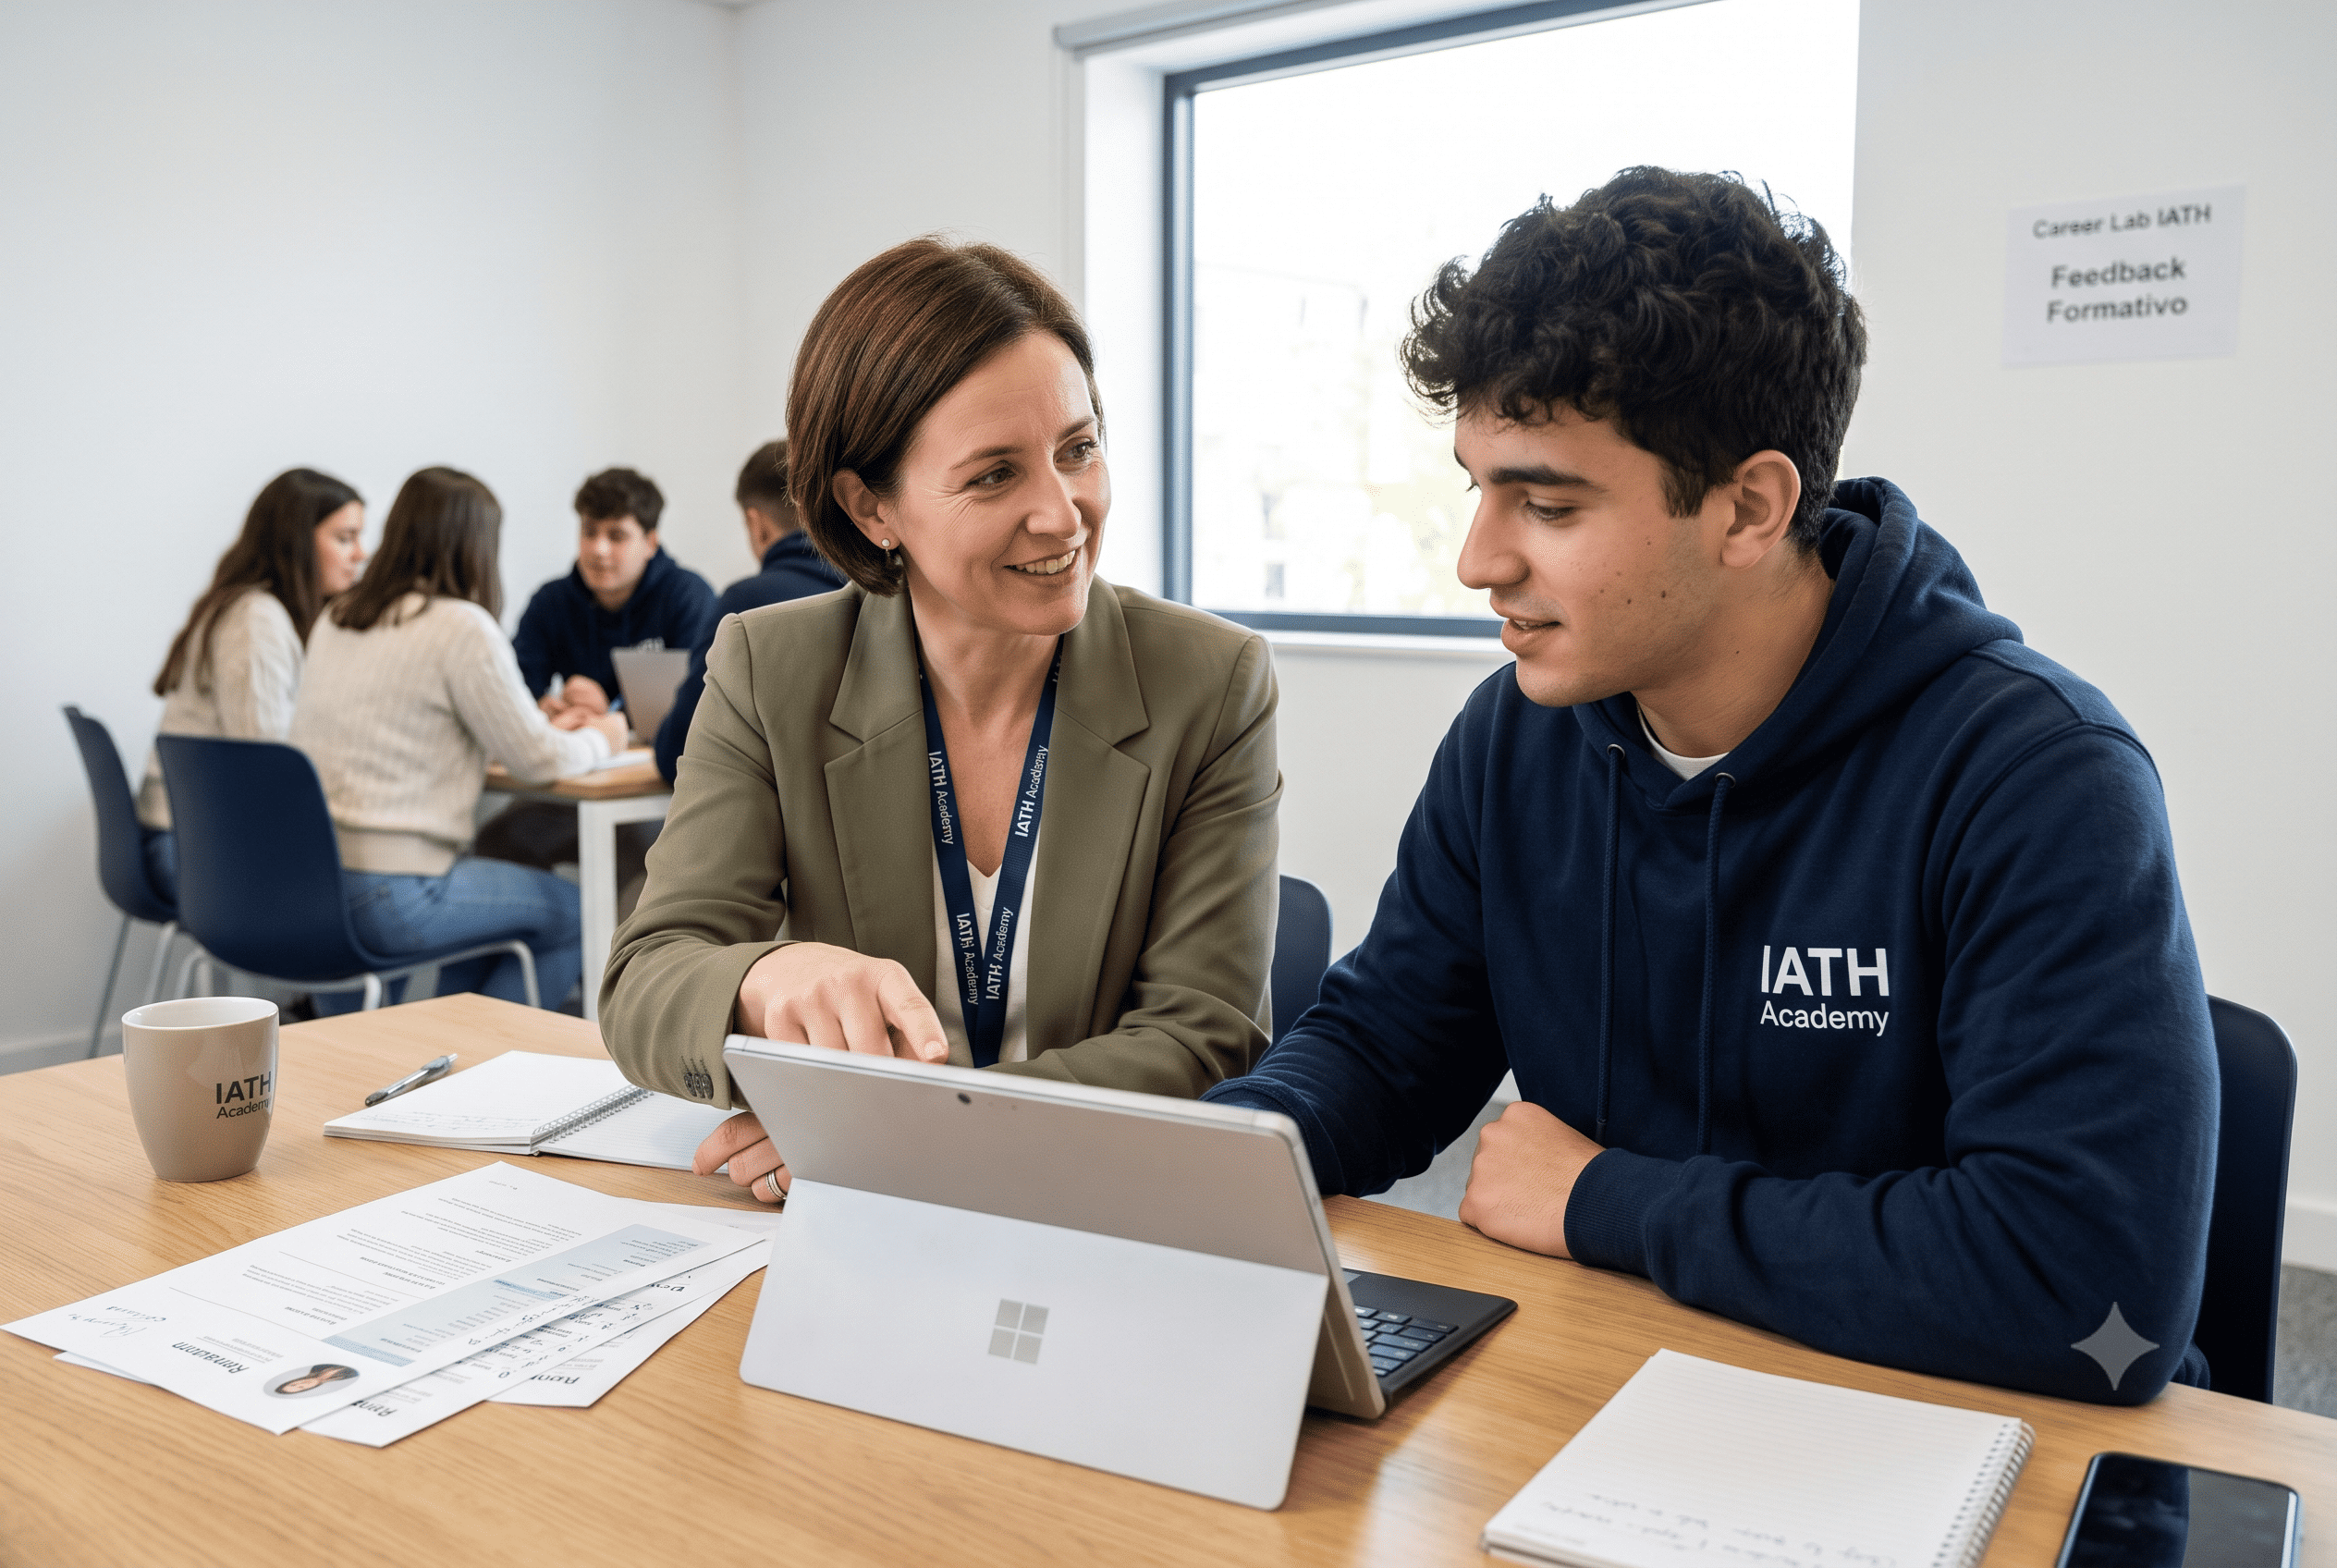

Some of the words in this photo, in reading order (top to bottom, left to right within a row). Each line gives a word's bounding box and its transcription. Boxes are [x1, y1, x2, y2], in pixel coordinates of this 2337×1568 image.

[2033, 218, 2104, 239] Career
[2110, 209, 2151, 233] Lab
[2157, 202, 2212, 227] IATH
[2050, 256, 2186, 288] Feedback
[2046, 293, 2189, 324] Formativo
[928, 751, 948, 787] IATH
[1014, 800, 1035, 838] IATH
[956, 913, 975, 949] IATH
[985, 963, 1003, 999] IATH
[1761, 945, 1890, 997] IATH
[1760, 1000, 1890, 1037] Academy
[215, 1071, 271, 1104] IATH
